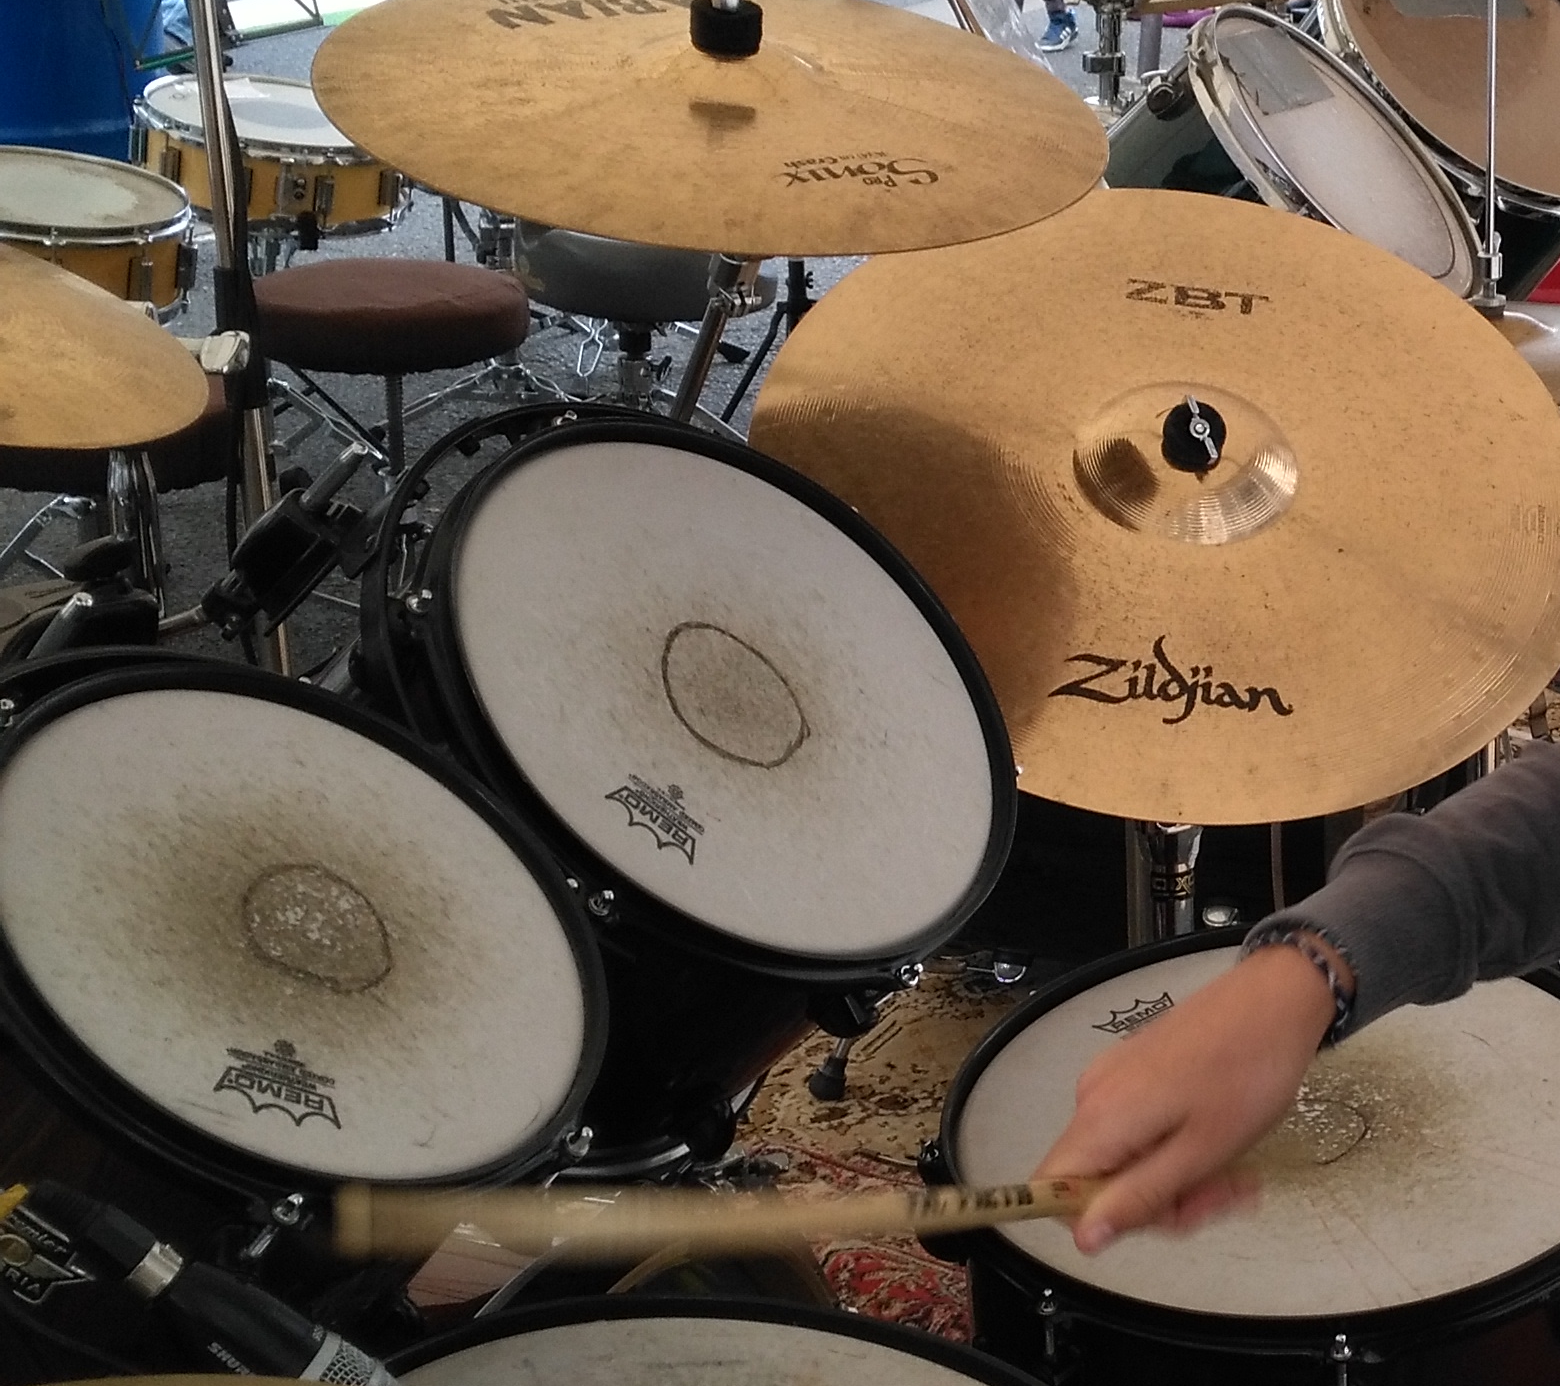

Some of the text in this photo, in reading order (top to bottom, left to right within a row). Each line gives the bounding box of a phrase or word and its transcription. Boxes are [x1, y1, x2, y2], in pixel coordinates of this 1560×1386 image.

[1125, 277, 1270, 317] ZBT
[1049, 635, 1293, 725] Zildjian
[624, 794, 689, 847] REMO
[1111, 999, 1168, 1031] REMO
[233, 1073, 324, 1112] REMO
[4, 1266, 41, 1294] RIA
